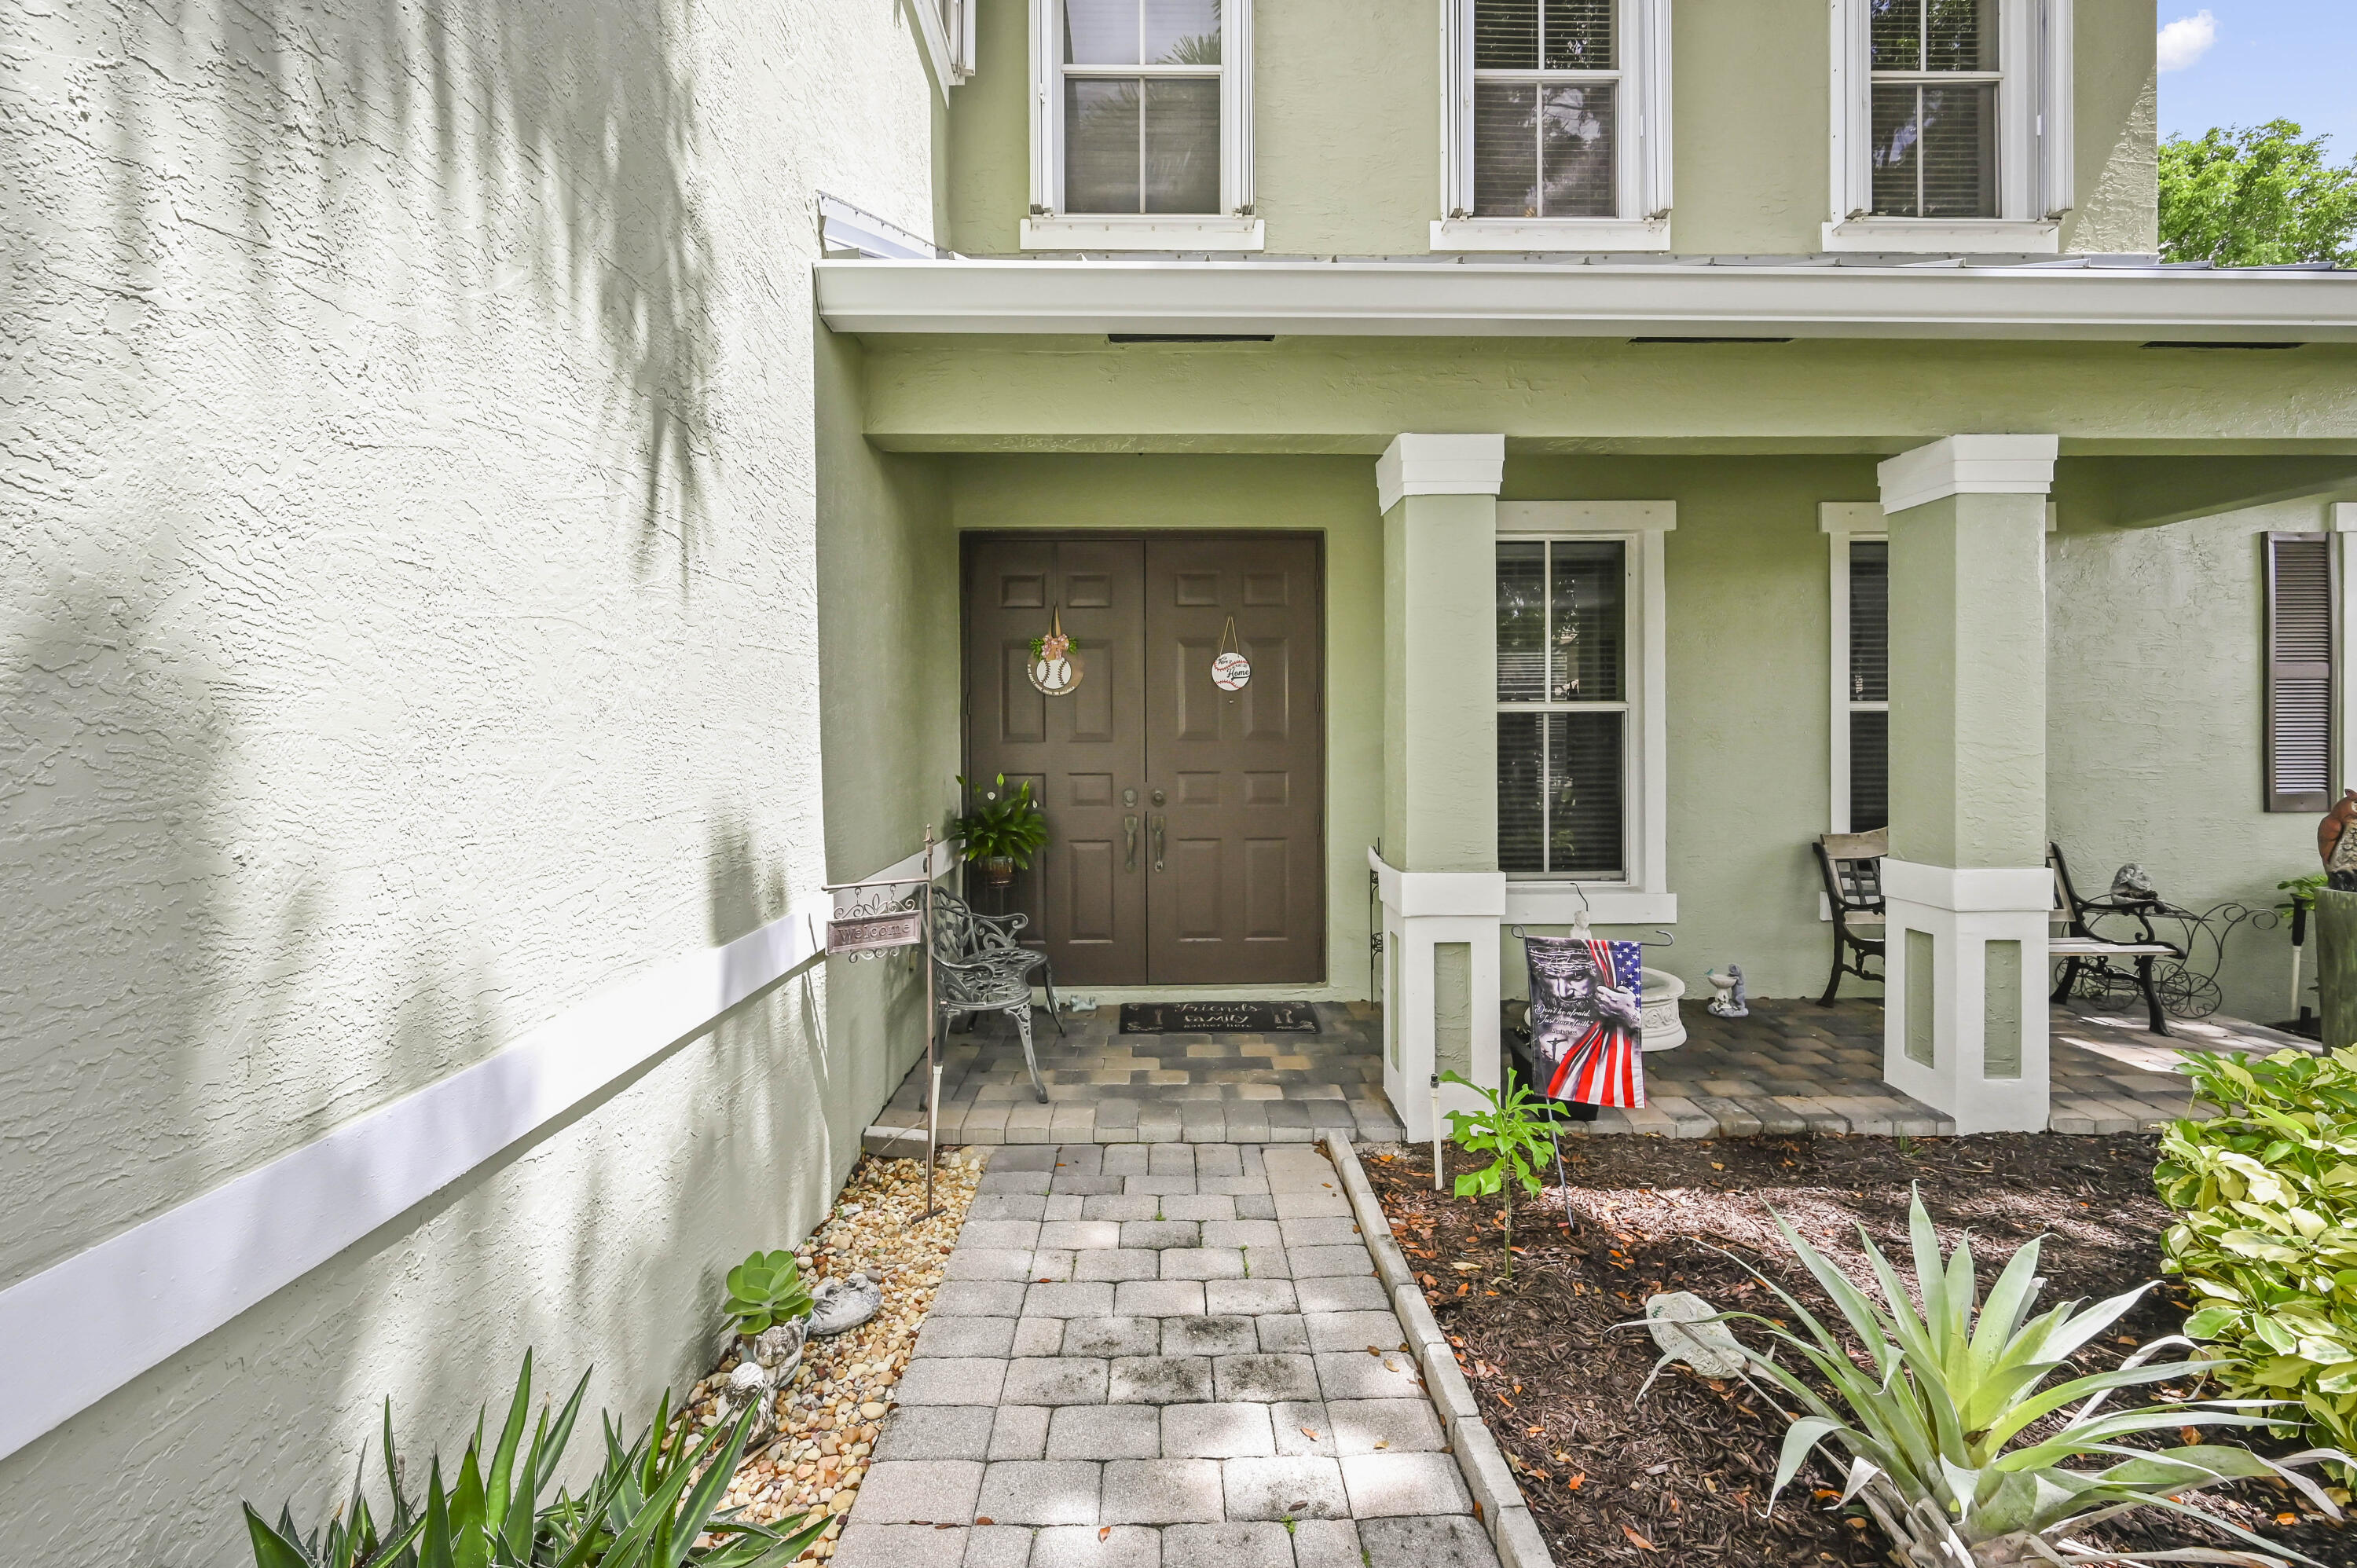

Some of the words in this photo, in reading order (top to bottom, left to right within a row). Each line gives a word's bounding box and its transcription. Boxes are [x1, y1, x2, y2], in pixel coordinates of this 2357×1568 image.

[1226, 668, 1251, 679] Home
[838, 923, 911, 944] Welcome
[1537, 1014, 1556, 1025] Just
